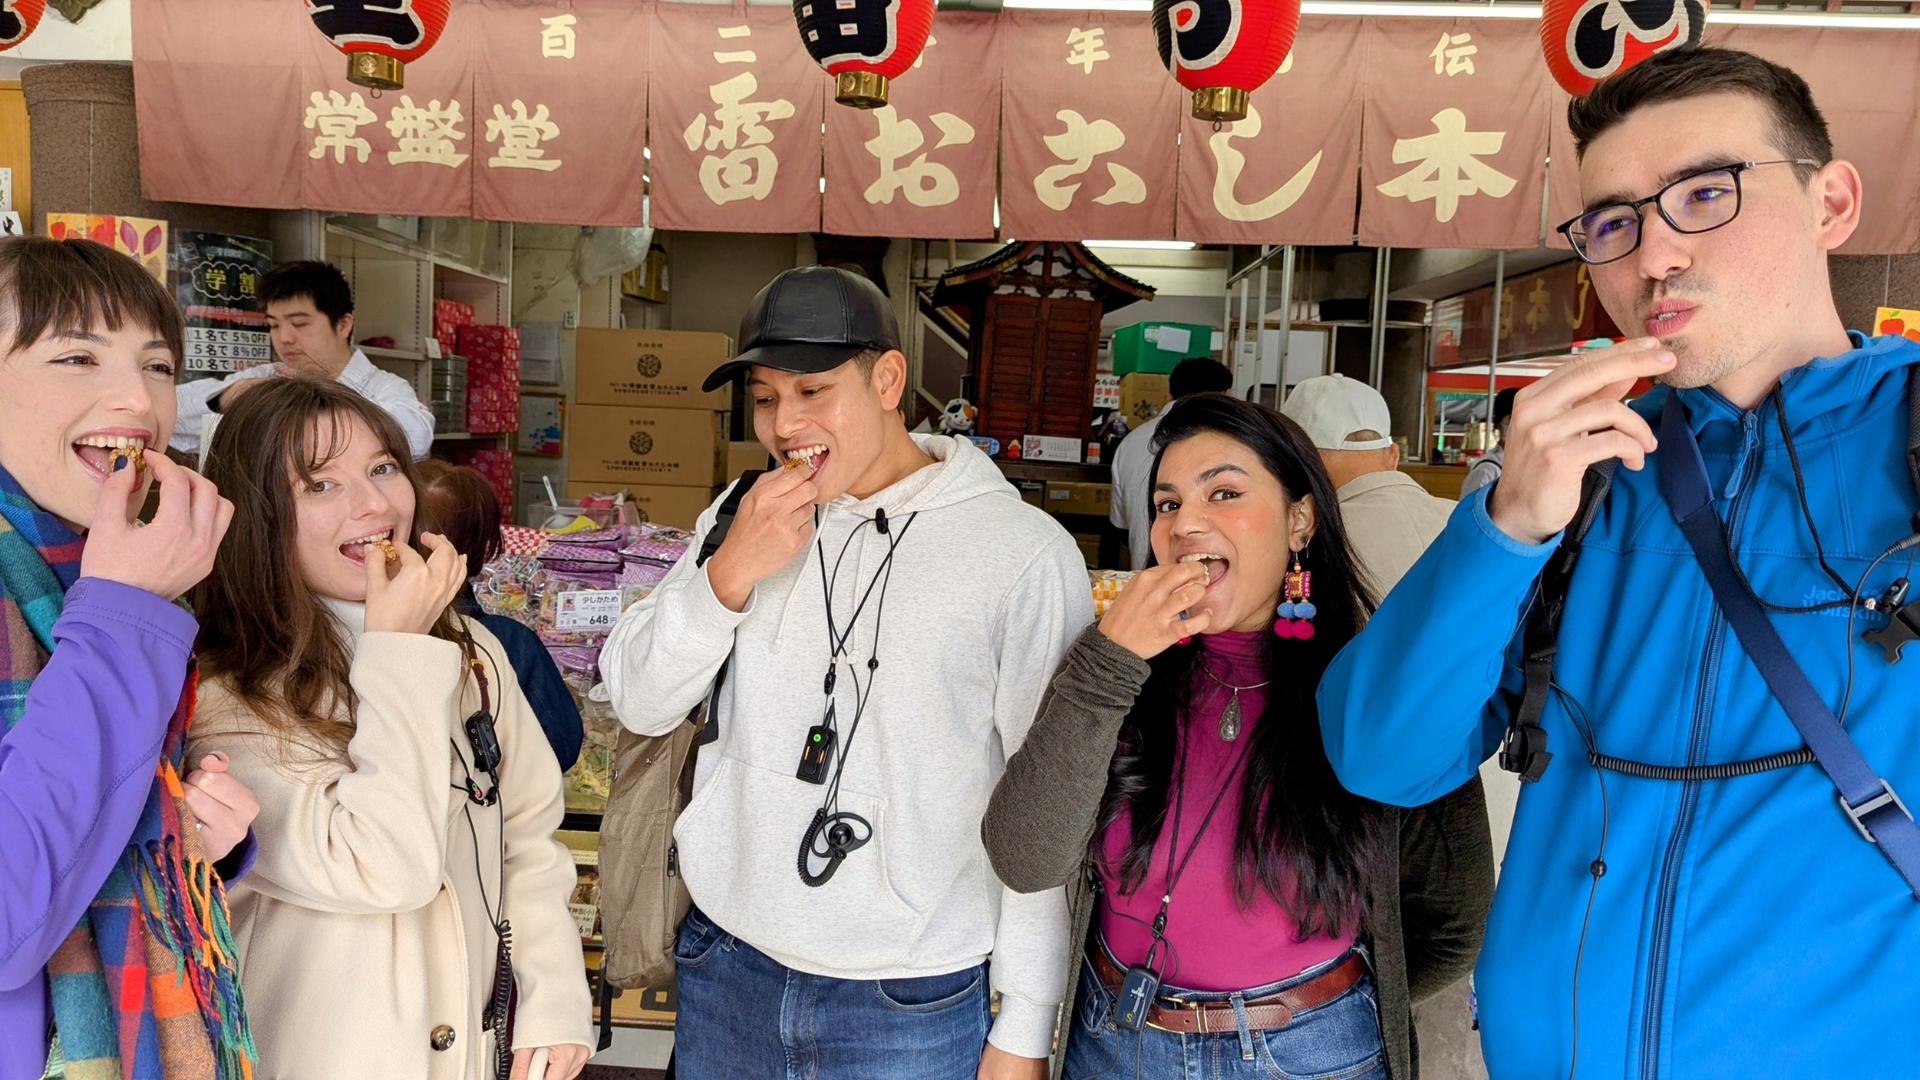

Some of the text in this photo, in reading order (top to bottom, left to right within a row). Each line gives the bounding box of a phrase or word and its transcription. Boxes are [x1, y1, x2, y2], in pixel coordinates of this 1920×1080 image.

[303, 90, 562, 172] 常盤堂
[582, 595, 618, 604] 少しかため
